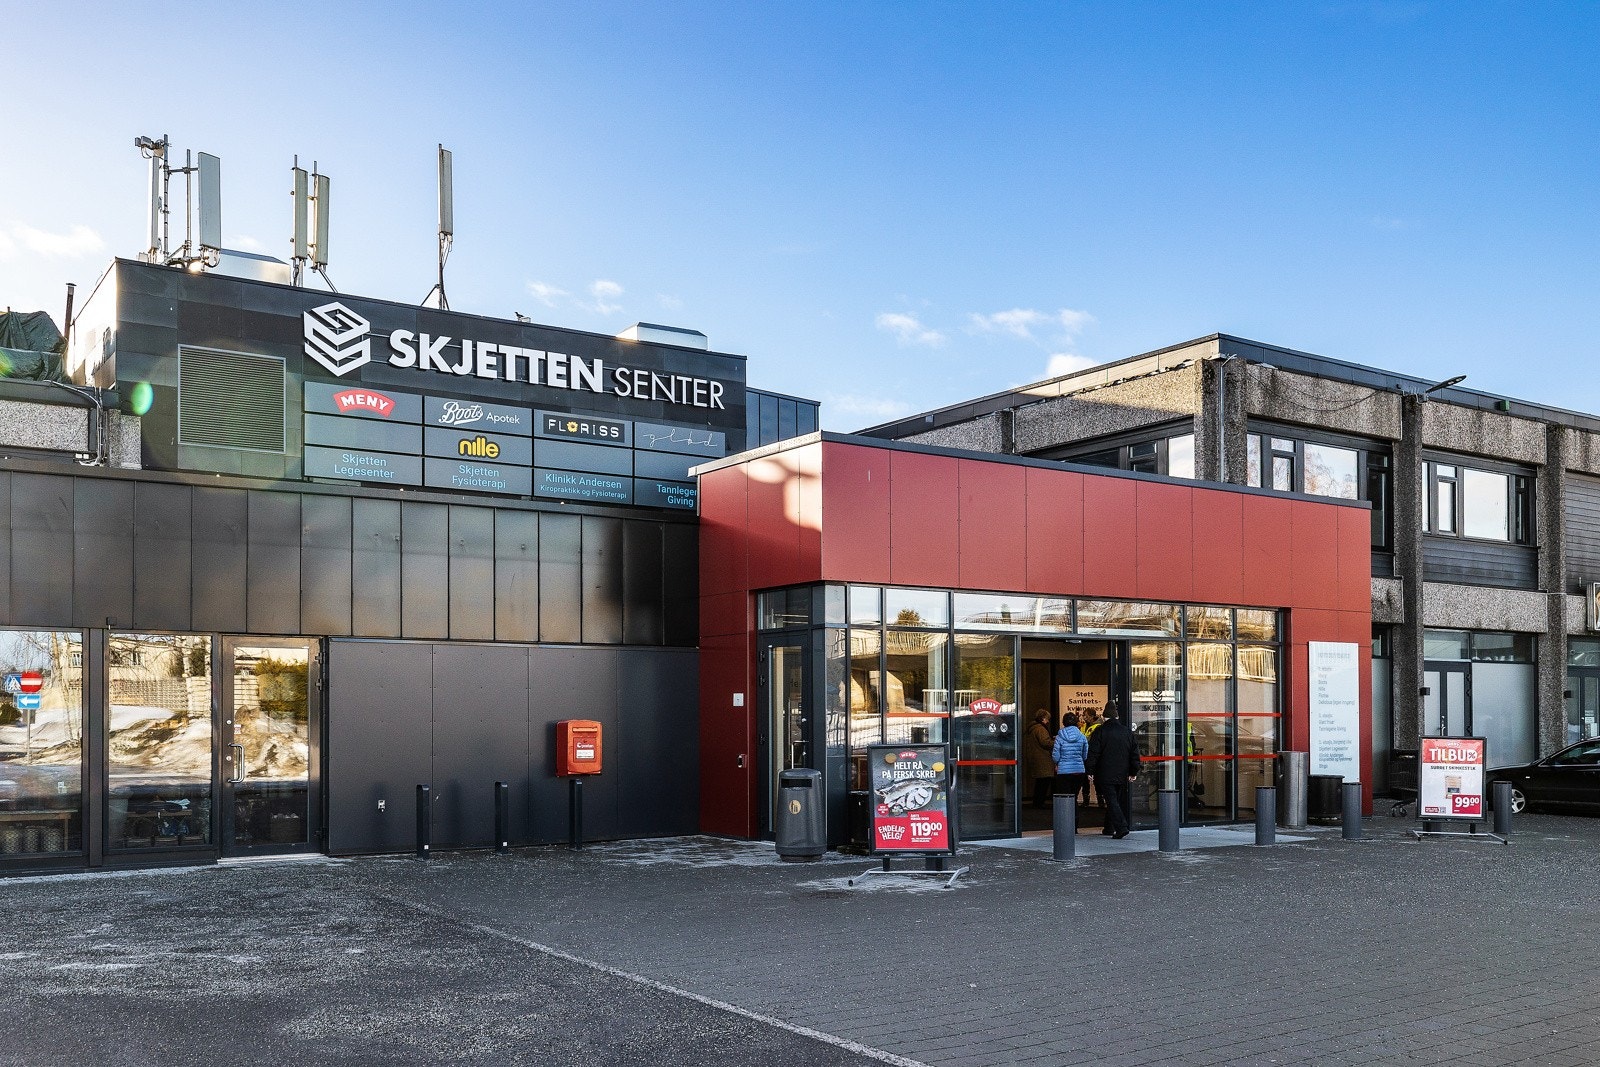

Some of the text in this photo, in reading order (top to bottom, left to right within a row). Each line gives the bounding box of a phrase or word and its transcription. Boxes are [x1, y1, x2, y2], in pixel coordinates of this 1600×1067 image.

[389, 329, 725, 410] SKJETTEN SENTER
[340, 394, 389, 411] MENY
[438, 401, 520, 425] Boots Apotek
[459, 436, 500, 458] nille
[342, 453, 387, 467] Skjetten
[334, 465, 395, 479] Legesenter
[459, 465, 500, 478] Skjetten
[452, 475, 506, 490] Fysioterapi
[545, 473, 622, 489] Klinikk Andersen
[540, 484, 581, 494] Kiropraktikk
[591, 489, 627, 500] Fysioterapi
[667, 495, 694, 508] Giving
[973, 701, 998, 711] MENY
[1429, 747, 1478, 762] TILBUD
[894, 760, 923, 770] HELT RÅ
[882, 770, 936, 778] PÅ FERSK SKREI
[878, 825, 905, 834] ENDELIG
